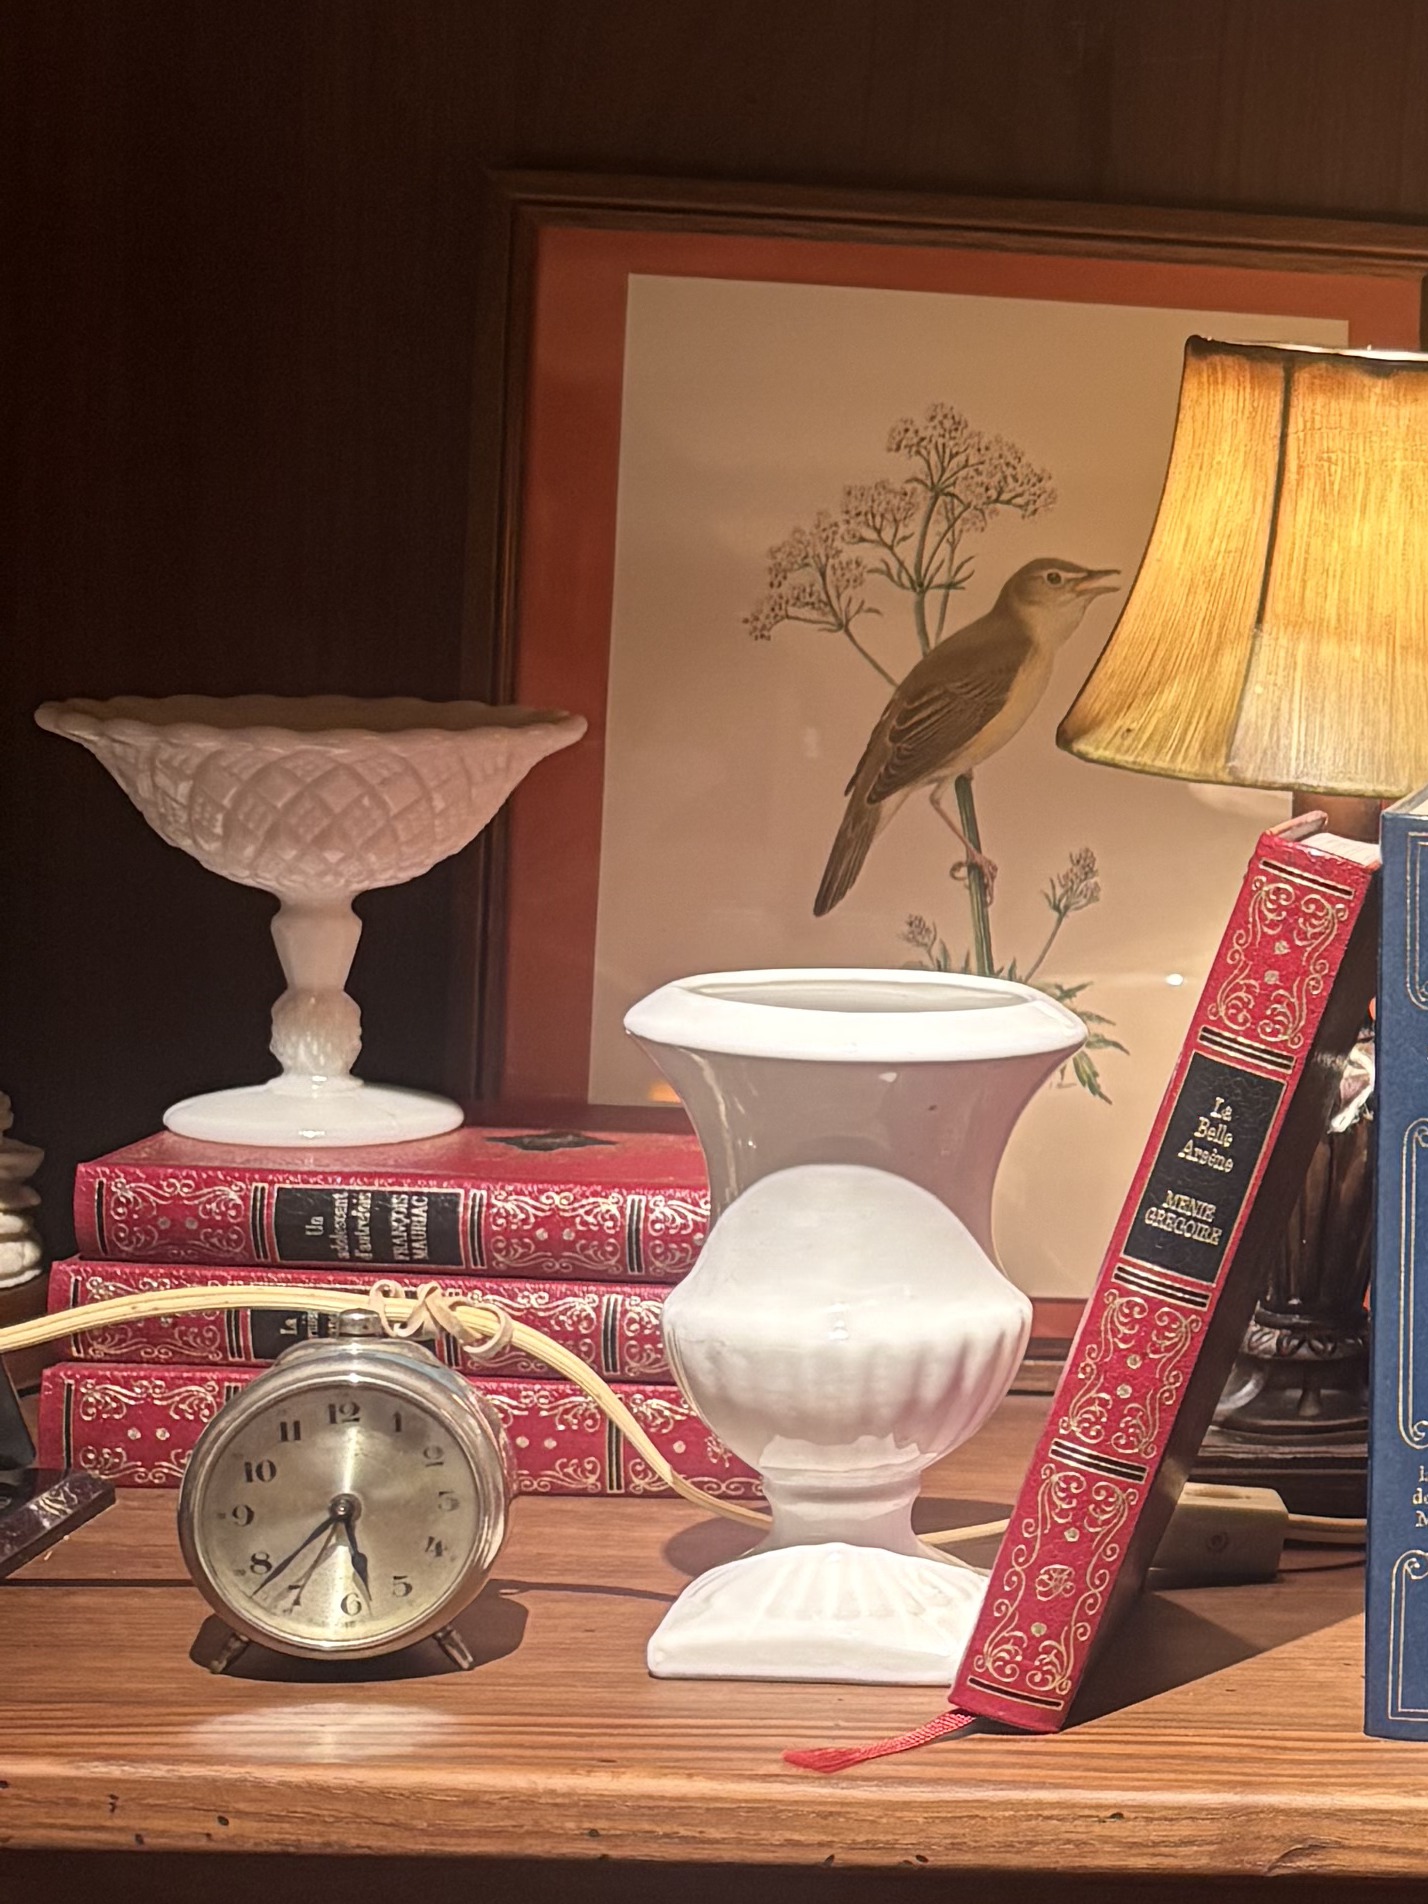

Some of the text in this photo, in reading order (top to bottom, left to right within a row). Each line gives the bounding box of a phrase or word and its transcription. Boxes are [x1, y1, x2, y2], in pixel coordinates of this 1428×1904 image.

[1209, 1096, 1234, 1122] La
[1193, 1115, 1234, 1148] Belle
[1177, 1138, 1235, 1174] Arsène
[304, 1215, 324, 1237] Un
[328, 1191, 351, 1260] adolescent
[390, 1193, 411, 1262] FRANÇOIS
[410, 1194, 429, 1261] MAURIAC
[327, 1401, 361, 1425] 12
[393, 1412, 403, 1434] 1
[279, 1420, 302, 1443] 11
[423, 1444, 446, 1468] 2
[243, 1459, 277, 1484] 10
[231, 1503, 256, 1528] 9
[424, 1535, 444, 1558] 4
[249, 1551, 273, 1576] 8
[392, 1575, 414, 1598] 5
[340, 1592, 362, 1617] 6
